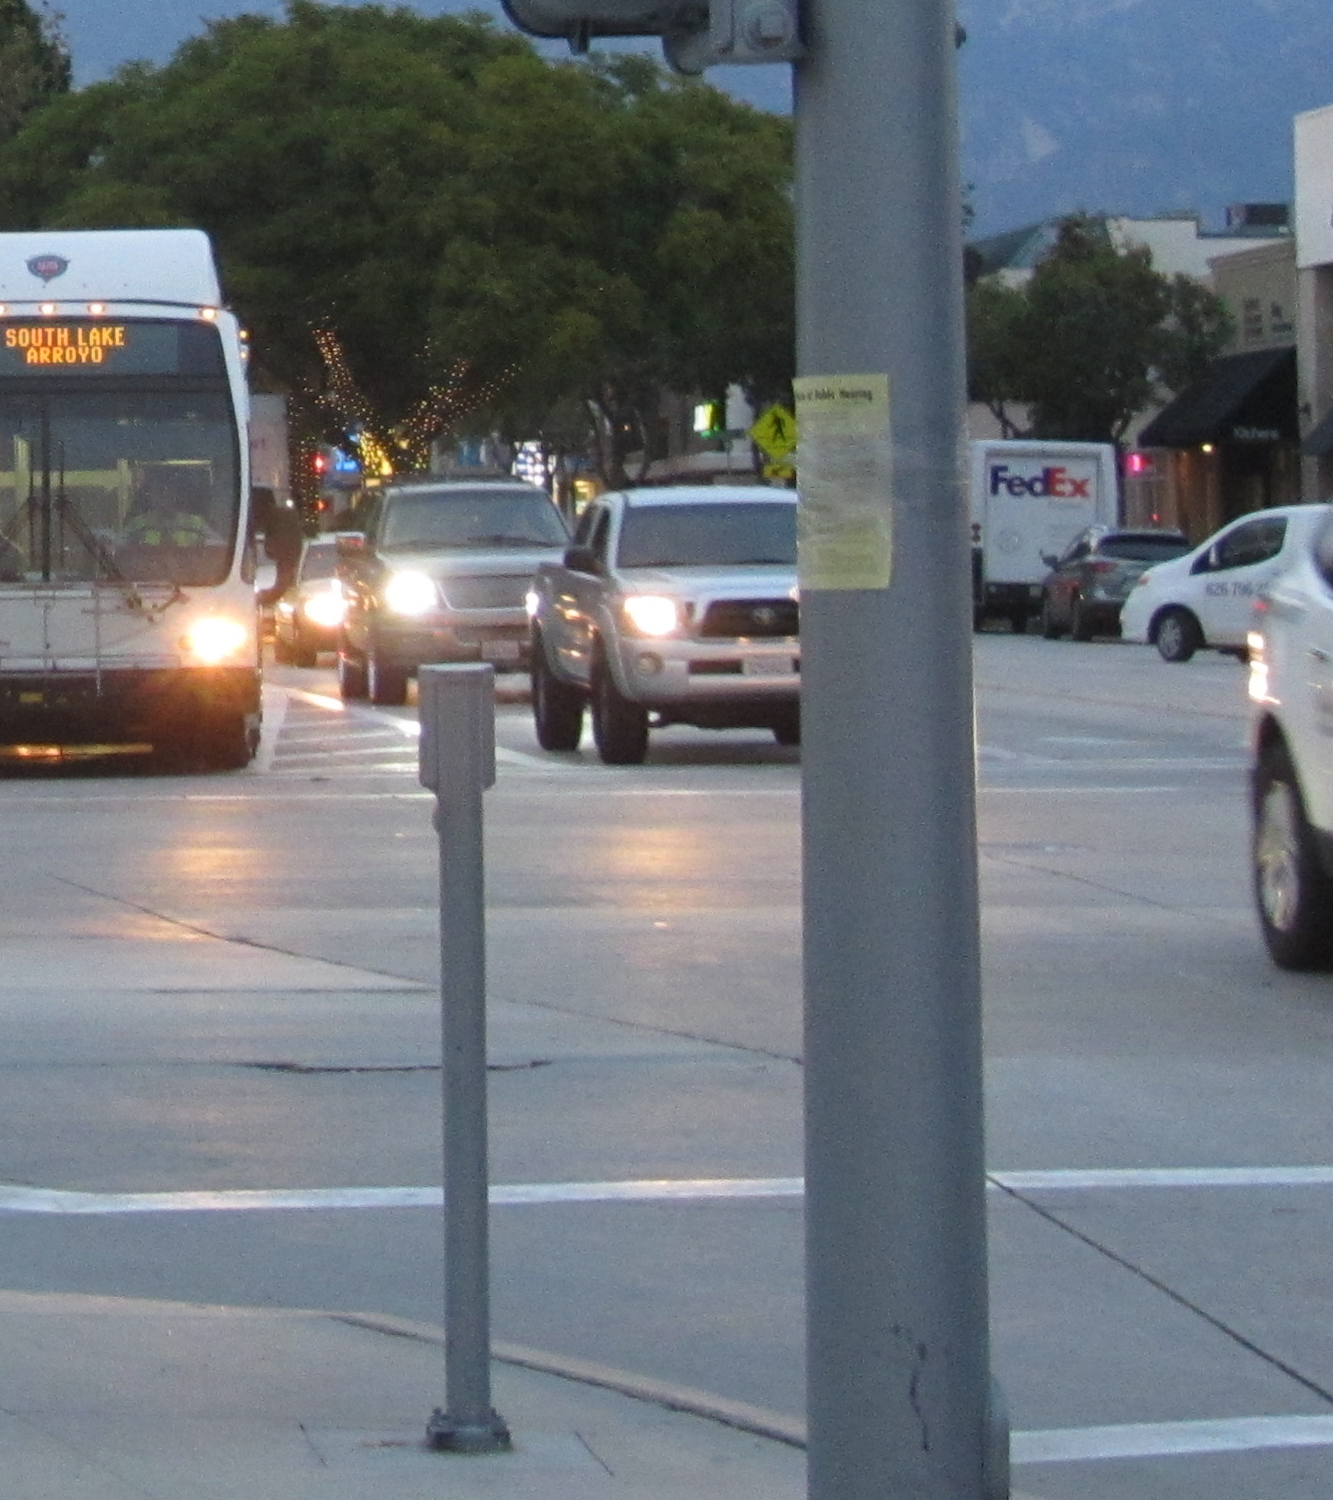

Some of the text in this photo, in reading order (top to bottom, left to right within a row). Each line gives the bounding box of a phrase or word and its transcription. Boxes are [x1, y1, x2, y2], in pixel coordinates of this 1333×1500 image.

[5, 327, 69, 348] SOUTH
[76, 326, 126, 347] LAKE
[25, 346, 103, 364] ARROYO
[989, 464, 1092, 498] FedEx
